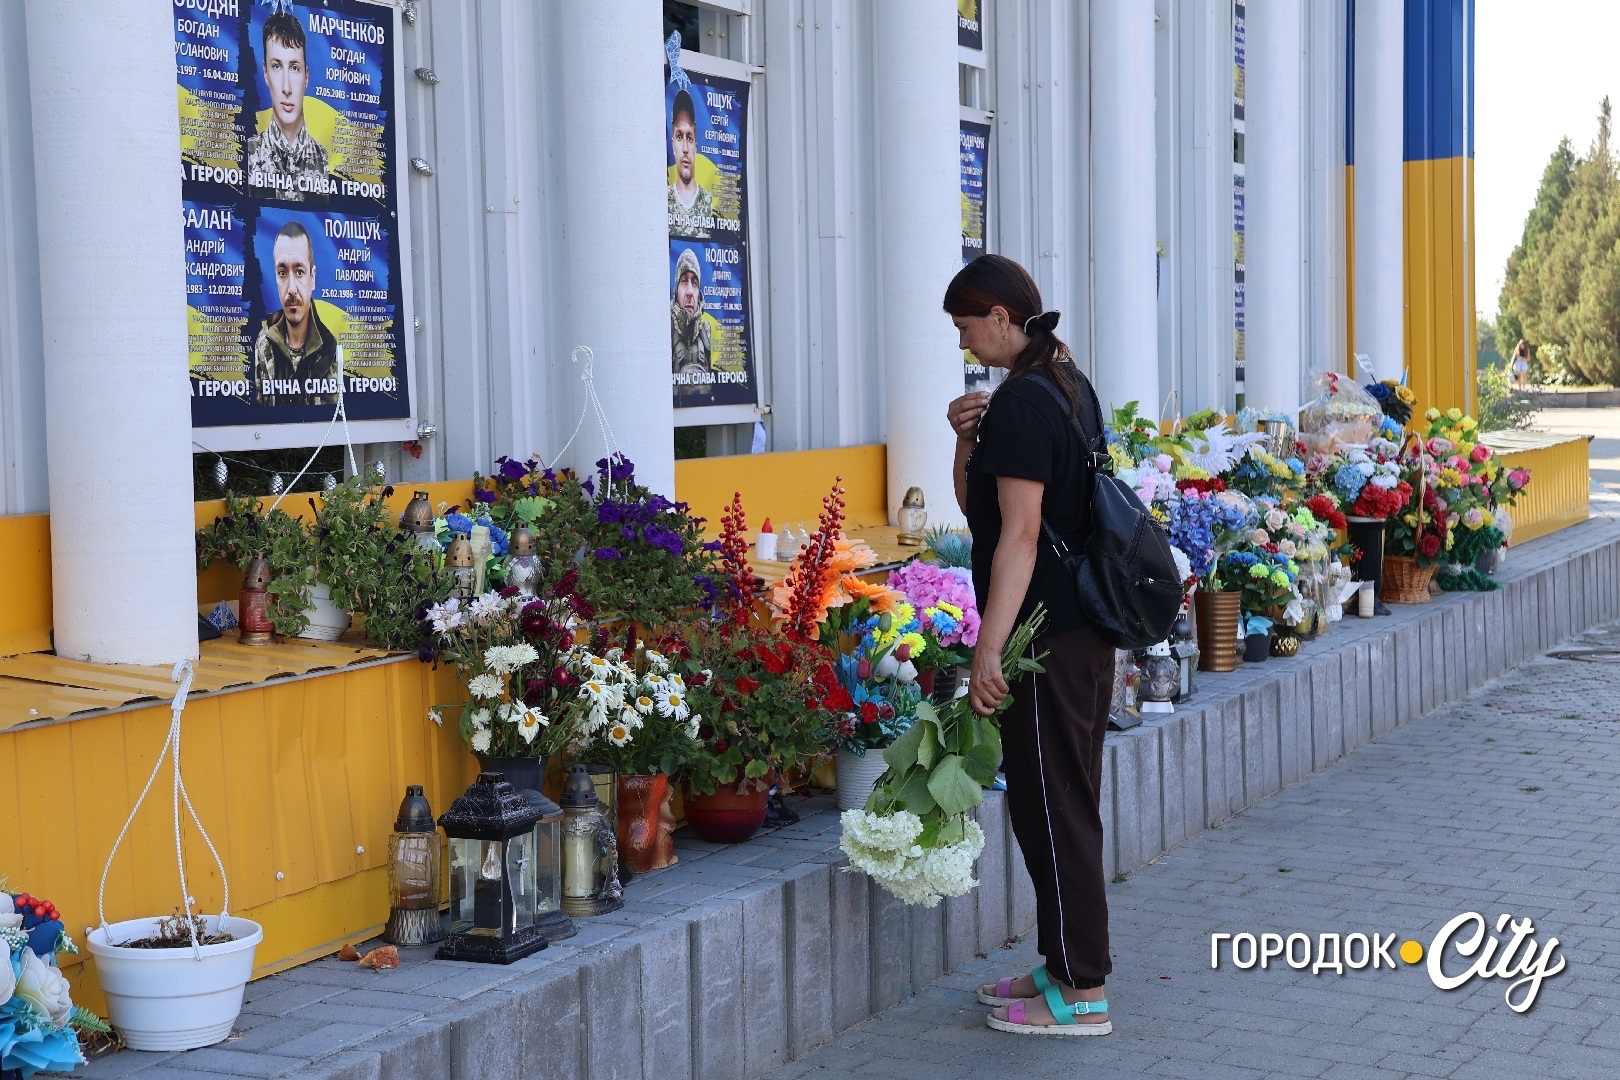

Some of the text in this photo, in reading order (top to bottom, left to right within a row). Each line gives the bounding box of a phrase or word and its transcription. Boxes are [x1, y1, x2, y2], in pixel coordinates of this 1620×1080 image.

[178, 19, 220, 40] БОГДАН
[309, 13, 385, 45] МАРЧЕНКОВ
[959, 17, 979, 33] ГЕРОЮ!
[331, 46, 366, 65] БОГДАН
[177, 64, 197, 76] .1997
[203, 68, 239, 82] 16.04.2023
[326, 67, 370, 86] ЮРІЙОВИЧ
[350, 91, 380, 105] 11.07.2023
[706, 91, 733, 111] ЯЩУК
[710, 114, 729, 127] СЕРГІЙ
[704, 129, 737, 144] СЕРГІЙОВИЧ
[191, 165, 243, 186] ГЕРОЮ!
[255, 171, 386, 199] ВІЧНА СЛАВА ГЕРОЮ!
[668, 212, 741, 231] ВІЧНА СЛАВА ГЕРОЮ!
[324, 218, 382, 245] ПОЛІЩУК
[186, 238, 225, 257] АНДРІЙ
[337, 247, 371, 264] АНДРІЙ
[705, 247, 739, 267] КОДІСОВ
[335, 268, 374, 282] ПАВЛОВИЧ
[712, 270, 732, 282] ДМИТРО
[208, 284, 243, 296] 12.07.2023
[703, 285, 742, 299] ОЛЕКСАНДРОВИЧ
[262, 377, 302, 395] ВІЧНА
[349, 376, 397, 393] ГЕРОЮ!
[692, 371, 716, 384] СЛАВА
[717, 371, 748, 384] ГЕРОЮ!
[198, 379, 250, 397] ГЕРОЮ!
